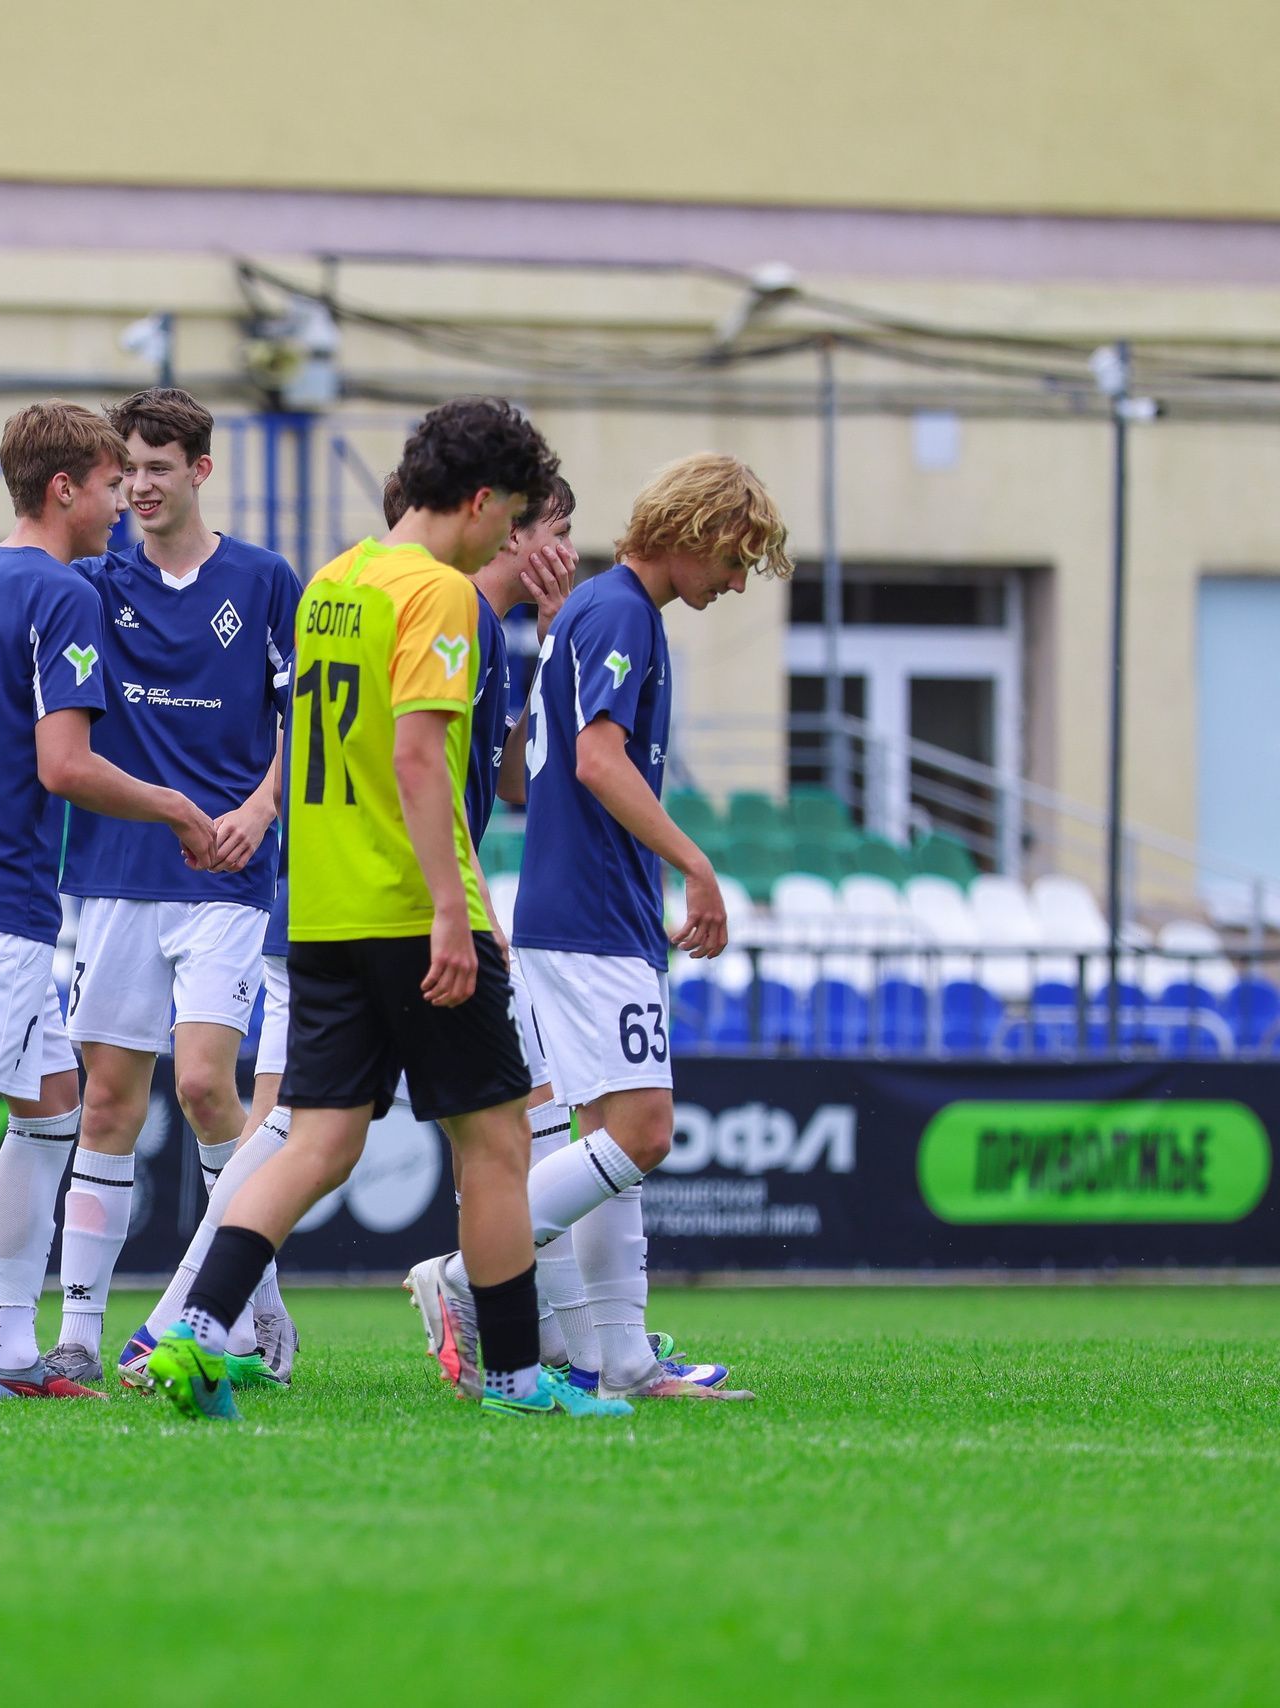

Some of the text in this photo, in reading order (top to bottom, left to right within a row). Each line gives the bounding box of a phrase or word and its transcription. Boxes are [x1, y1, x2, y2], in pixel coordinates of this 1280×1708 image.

[114, 618, 140, 629] KELME
[306, 600, 362, 639] ВОЛГА
[146, 696, 222, 709] ТРАНССТРОЙ
[147, 688, 170, 697] ДСК
[295, 659, 361, 806] 17
[620, 1003, 667, 1064] 63
